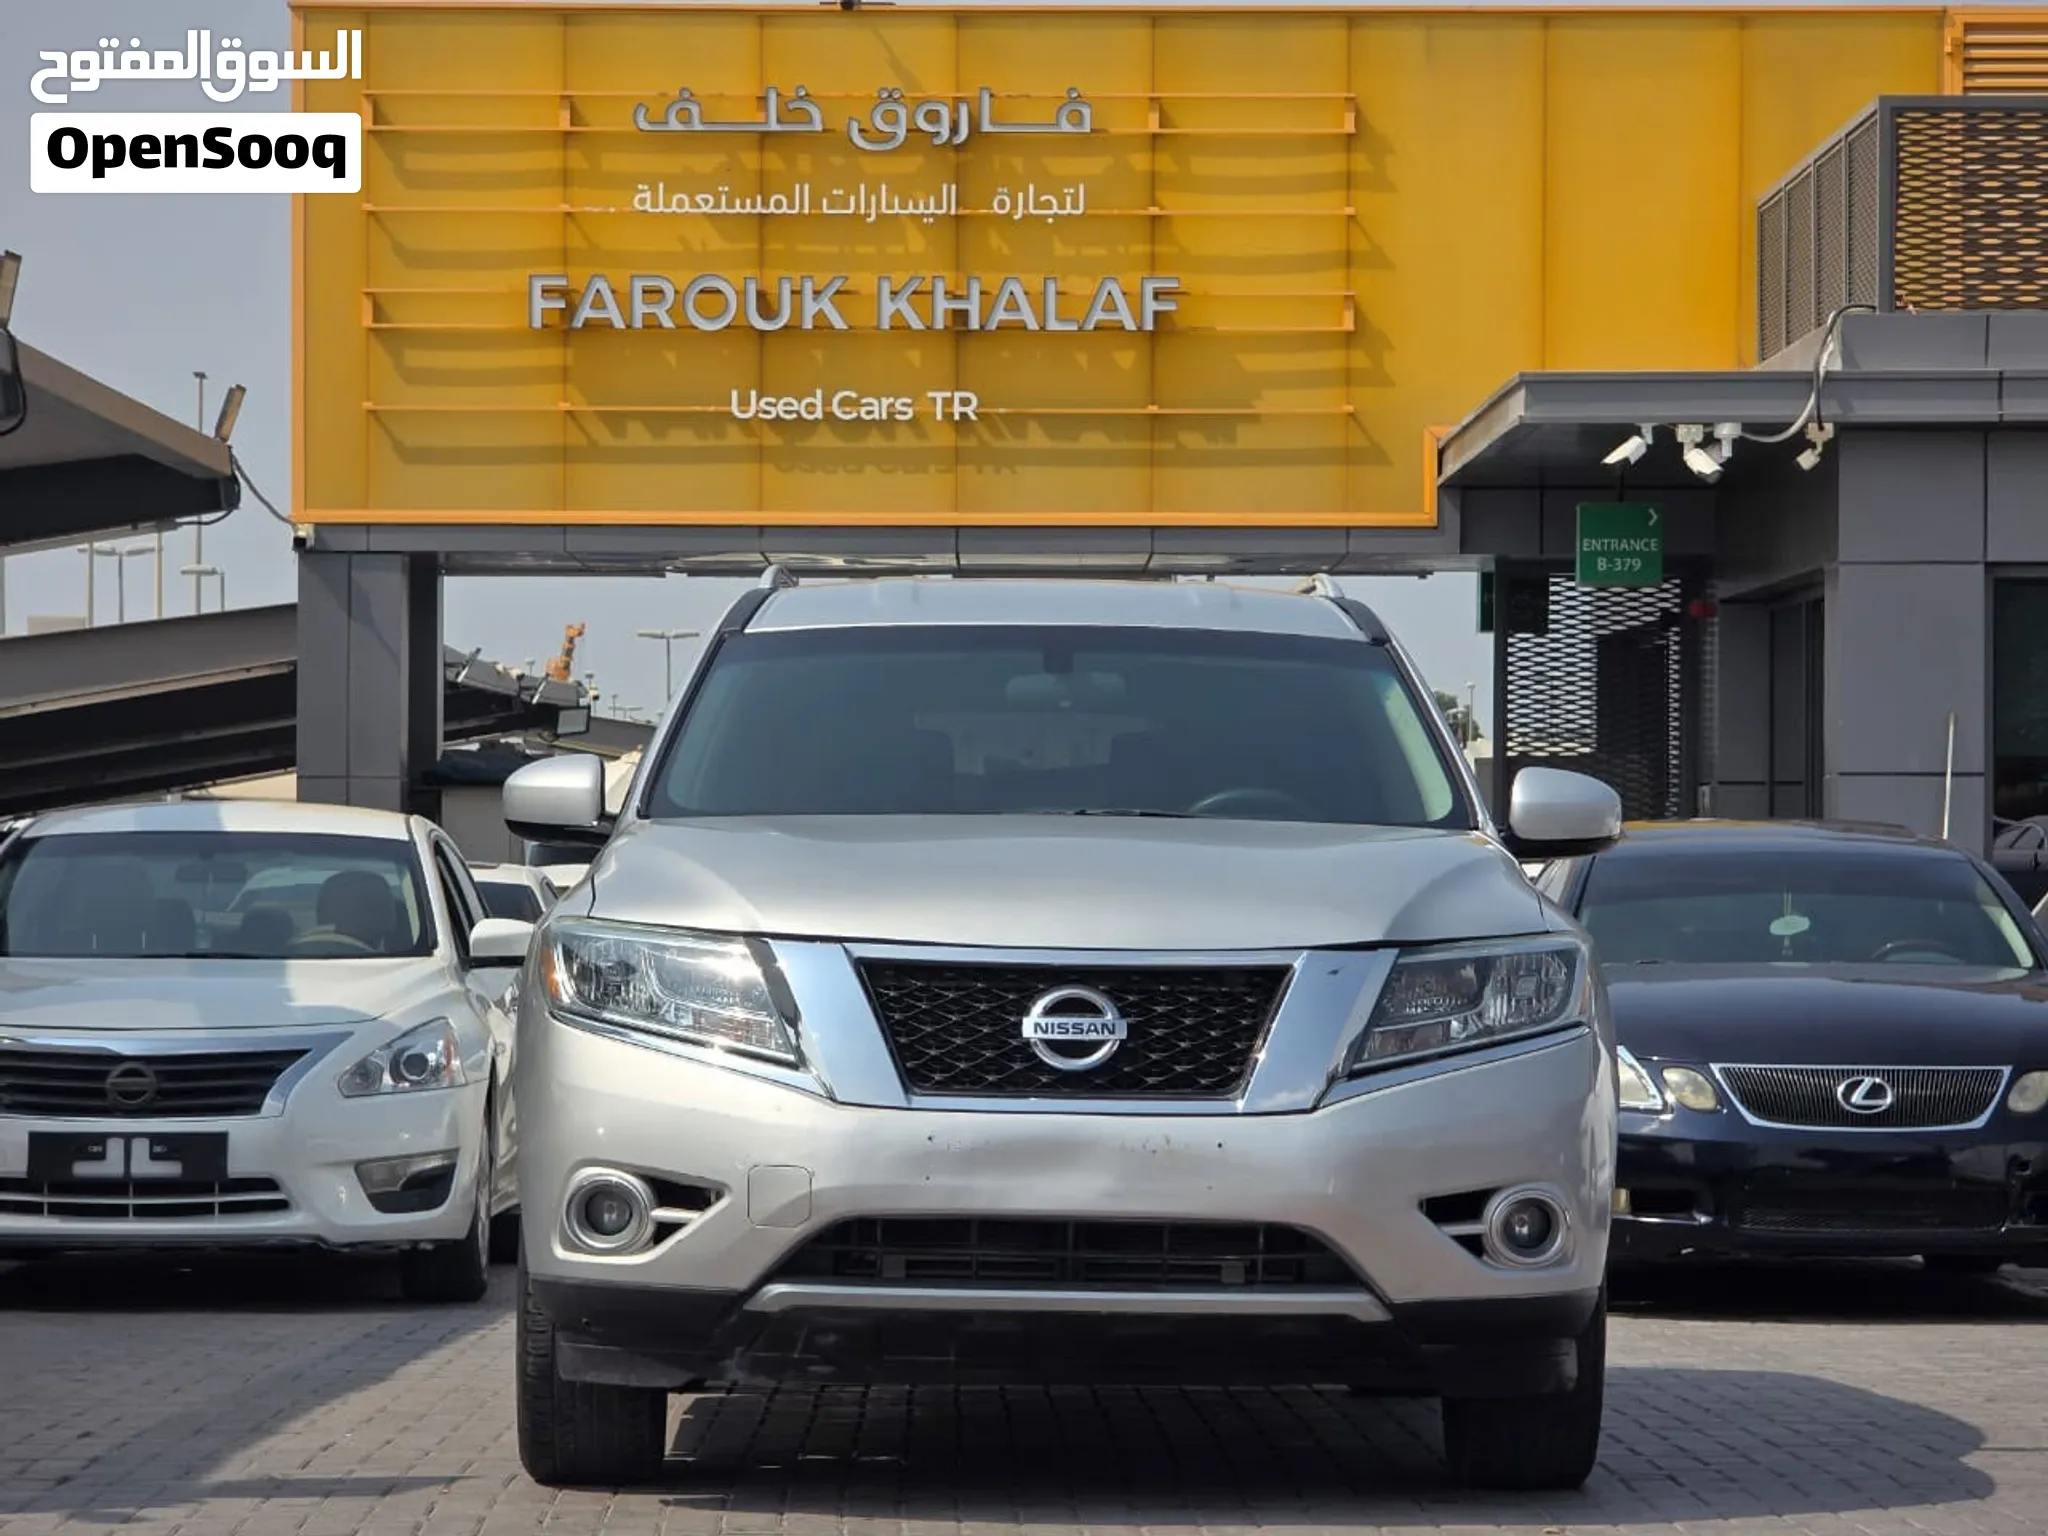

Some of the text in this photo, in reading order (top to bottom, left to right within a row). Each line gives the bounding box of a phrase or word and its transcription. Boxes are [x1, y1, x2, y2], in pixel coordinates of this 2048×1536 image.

[633, 86, 823, 132] خلف
[632, 181, 811, 214] المستعملة
[993, 182, 1085, 223] لتجارة
[527, 273, 1180, 331] FAROUK KHALAF
[730, 388, 979, 421] Used Cars TR
[1582, 538, 1659, 552] ENTRANCE
[1596, 557, 1642, 572] B-379
[1033, 1022, 1117, 1036] NISSAN
